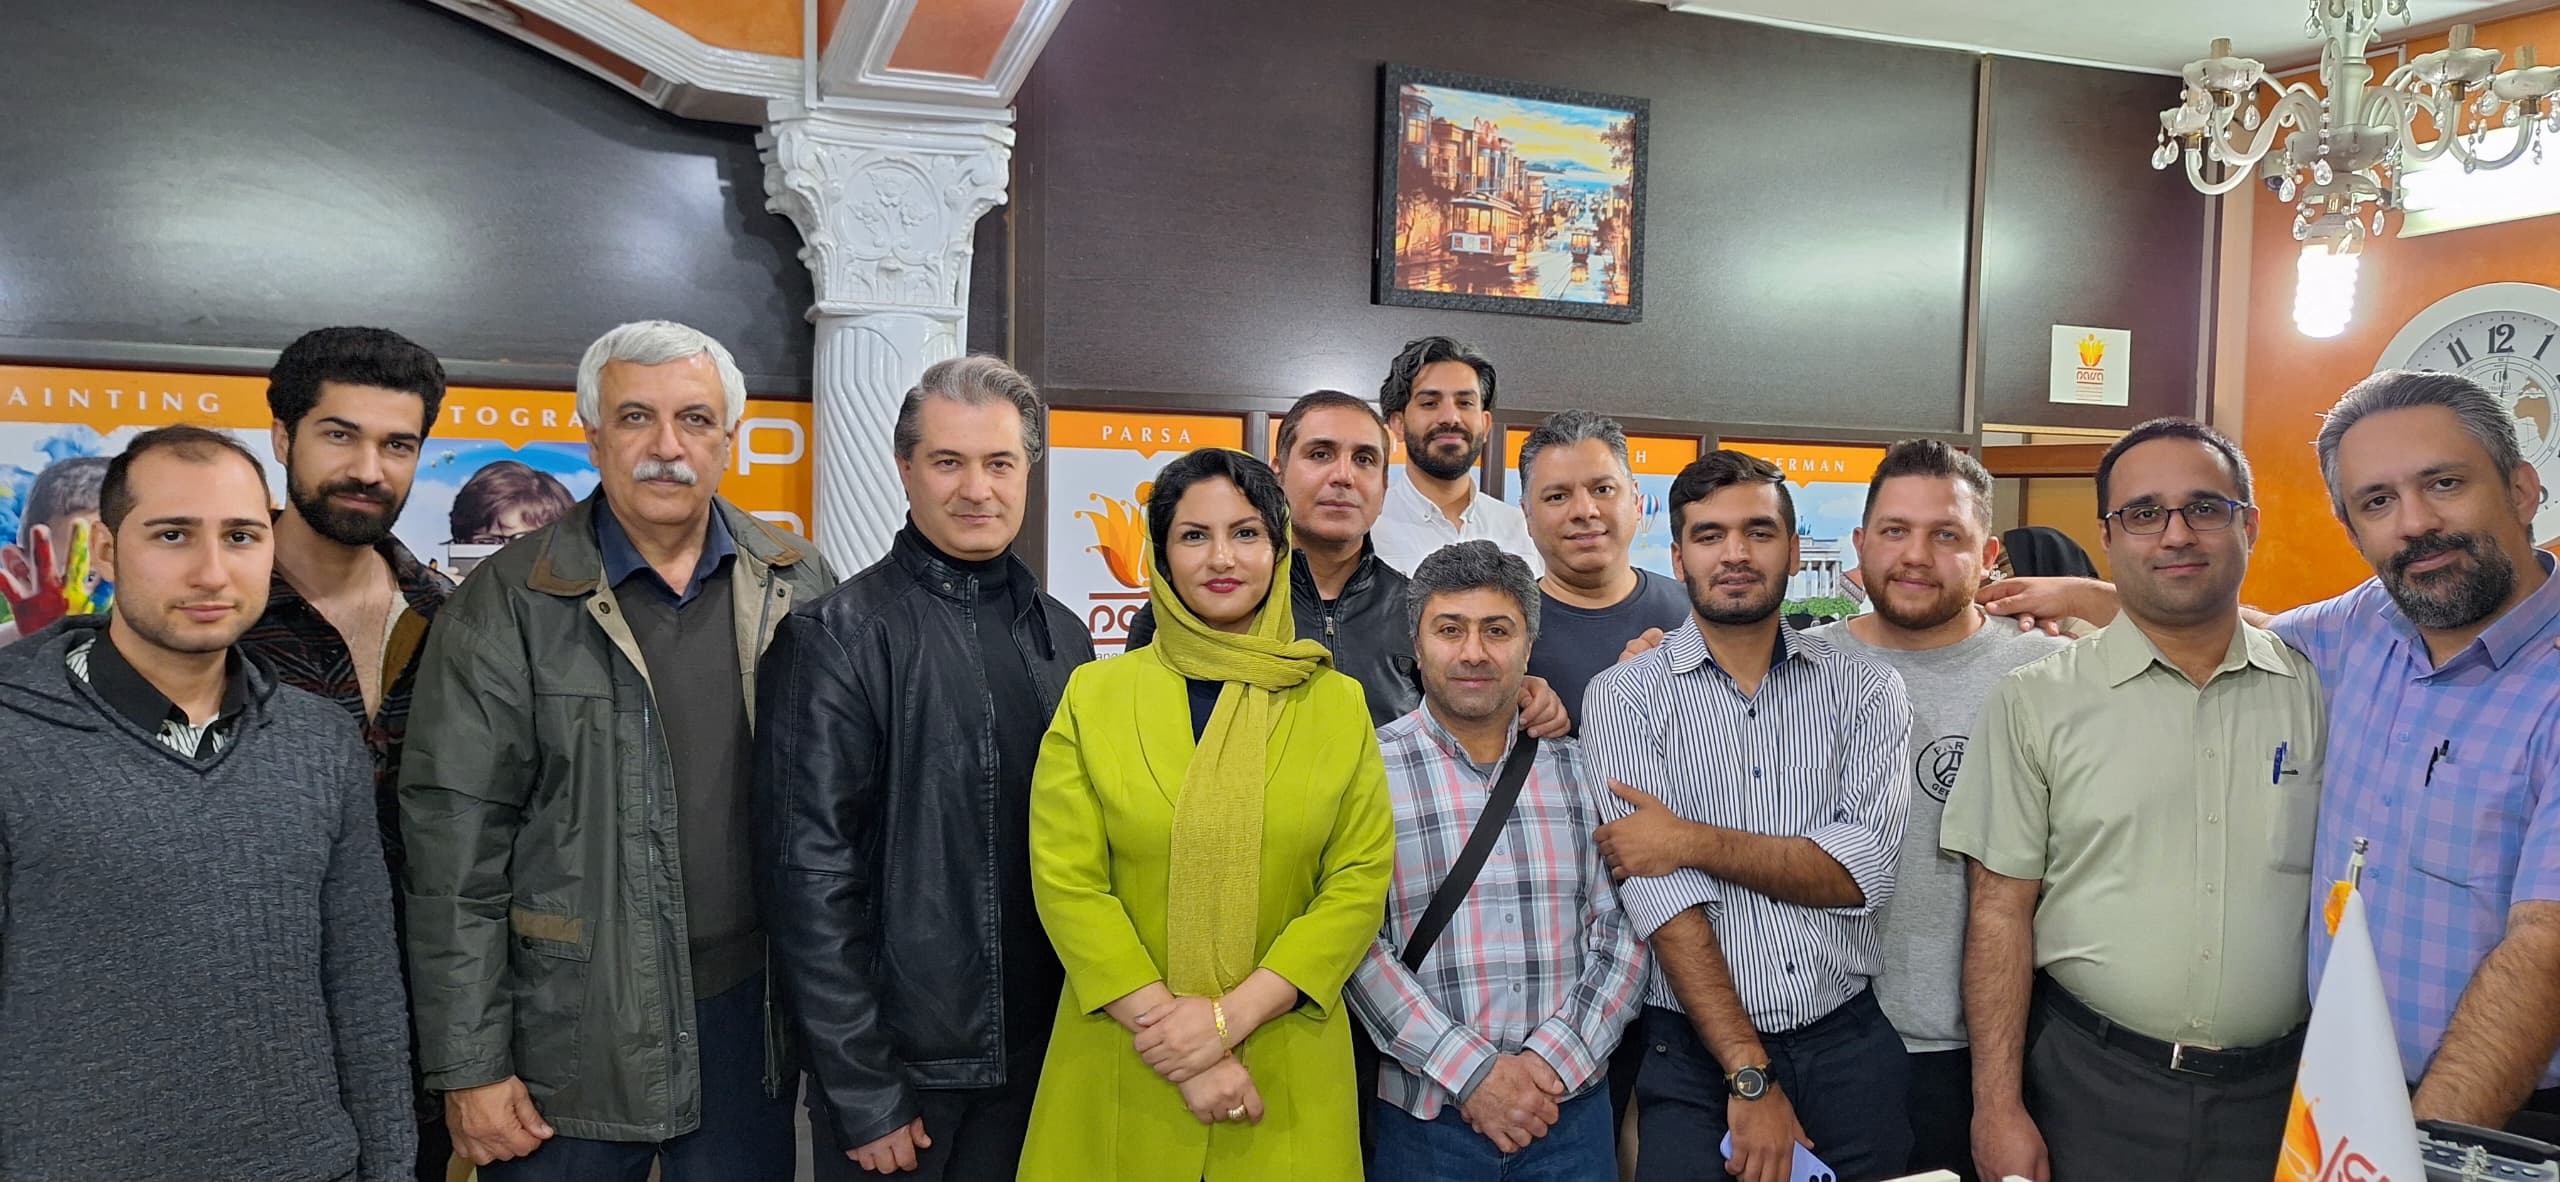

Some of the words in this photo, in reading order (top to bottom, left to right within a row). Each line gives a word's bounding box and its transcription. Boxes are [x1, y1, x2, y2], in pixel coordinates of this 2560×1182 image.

[2446, 337, 2474, 368] 11
[2487, 323, 2516, 354] 12
[2532, 333, 2555, 361] 1
[7, 385, 221, 414] AINTING
[1101, 425, 1192, 443] PARSA
[1760, 456, 1845, 473] ERMAN
